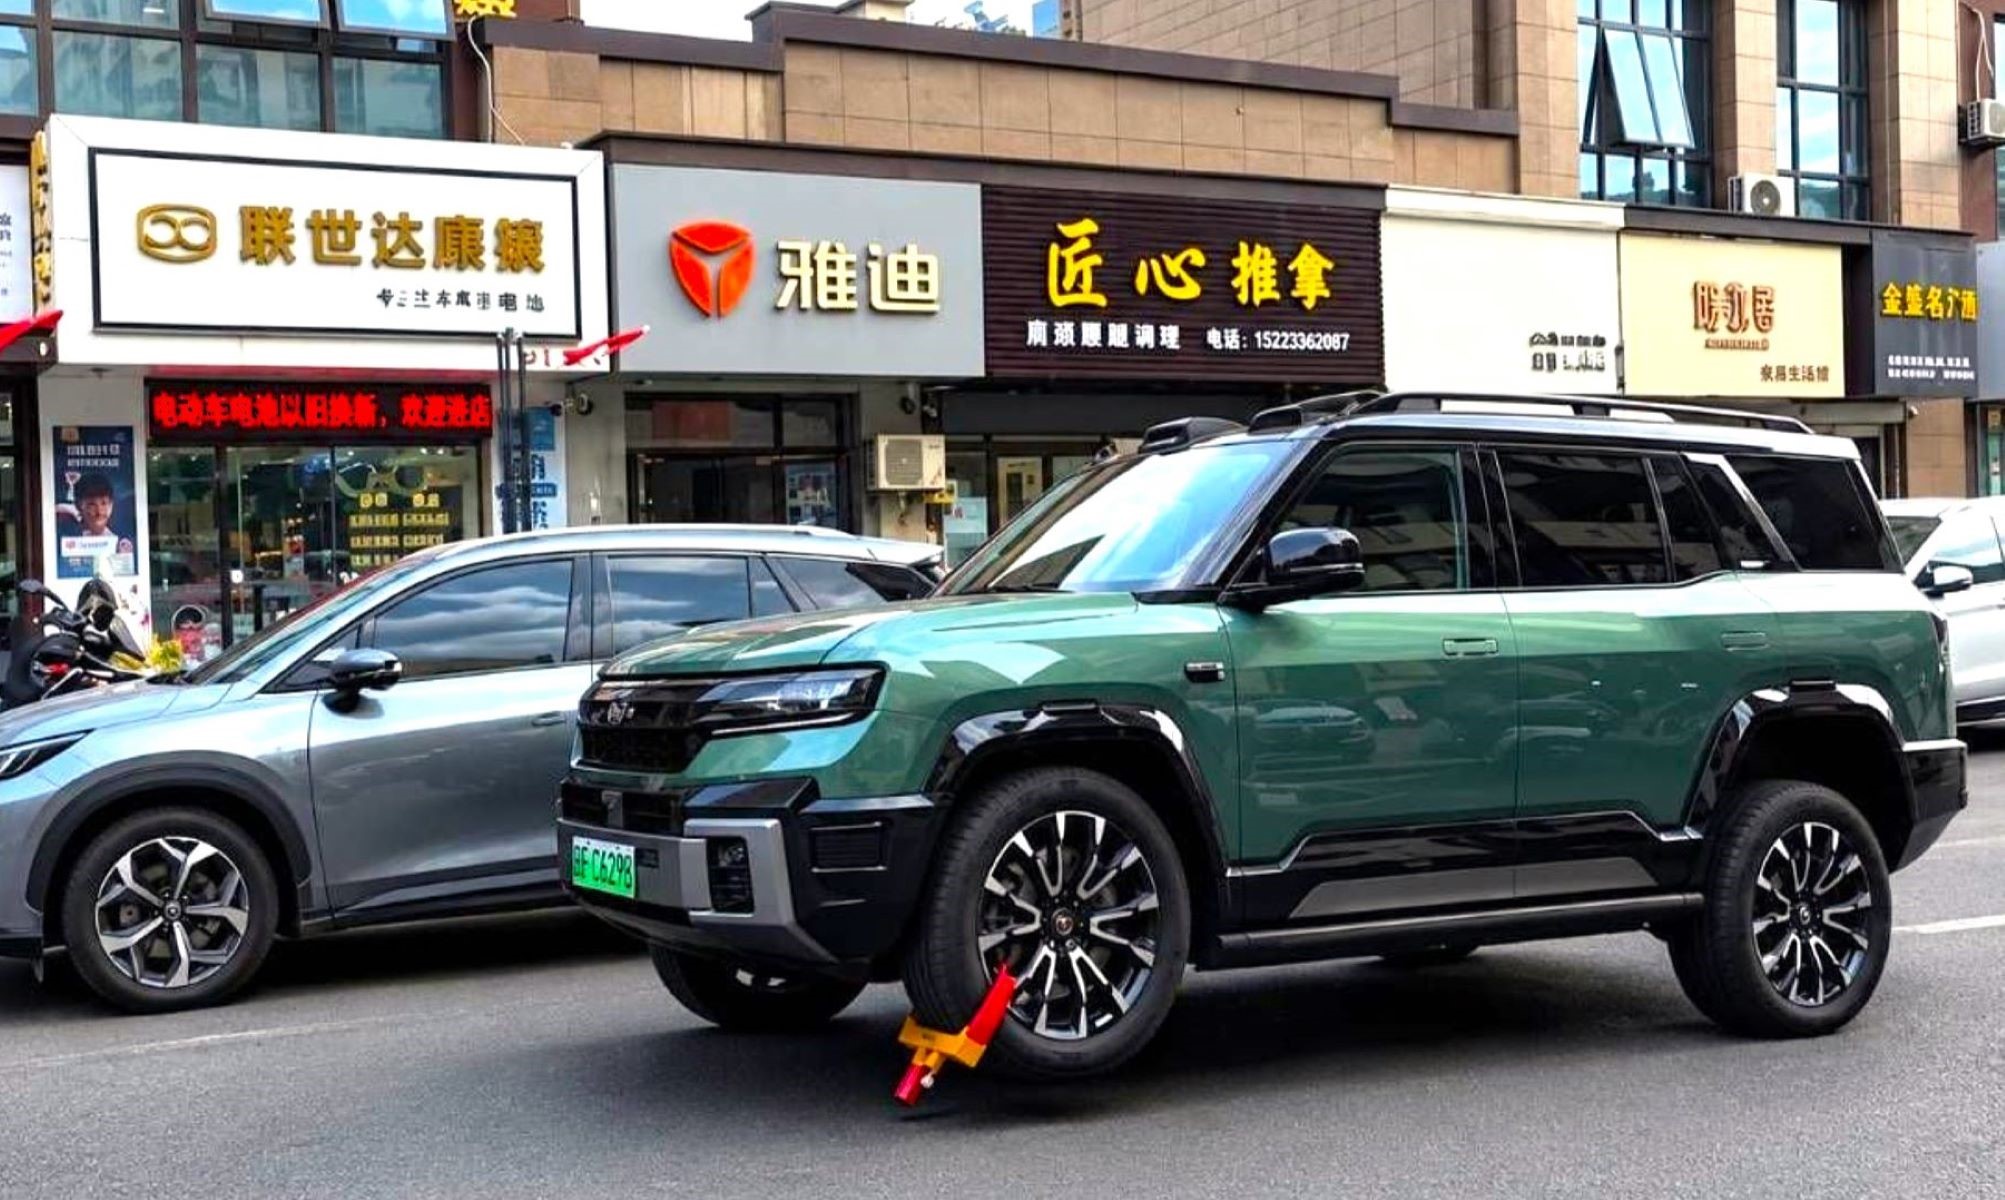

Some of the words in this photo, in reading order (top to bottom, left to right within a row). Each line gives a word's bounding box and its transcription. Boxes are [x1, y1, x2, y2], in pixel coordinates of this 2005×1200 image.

[777, 240, 940, 311] 雅迪
[1049, 218, 1335, 310] 匠心推拿
